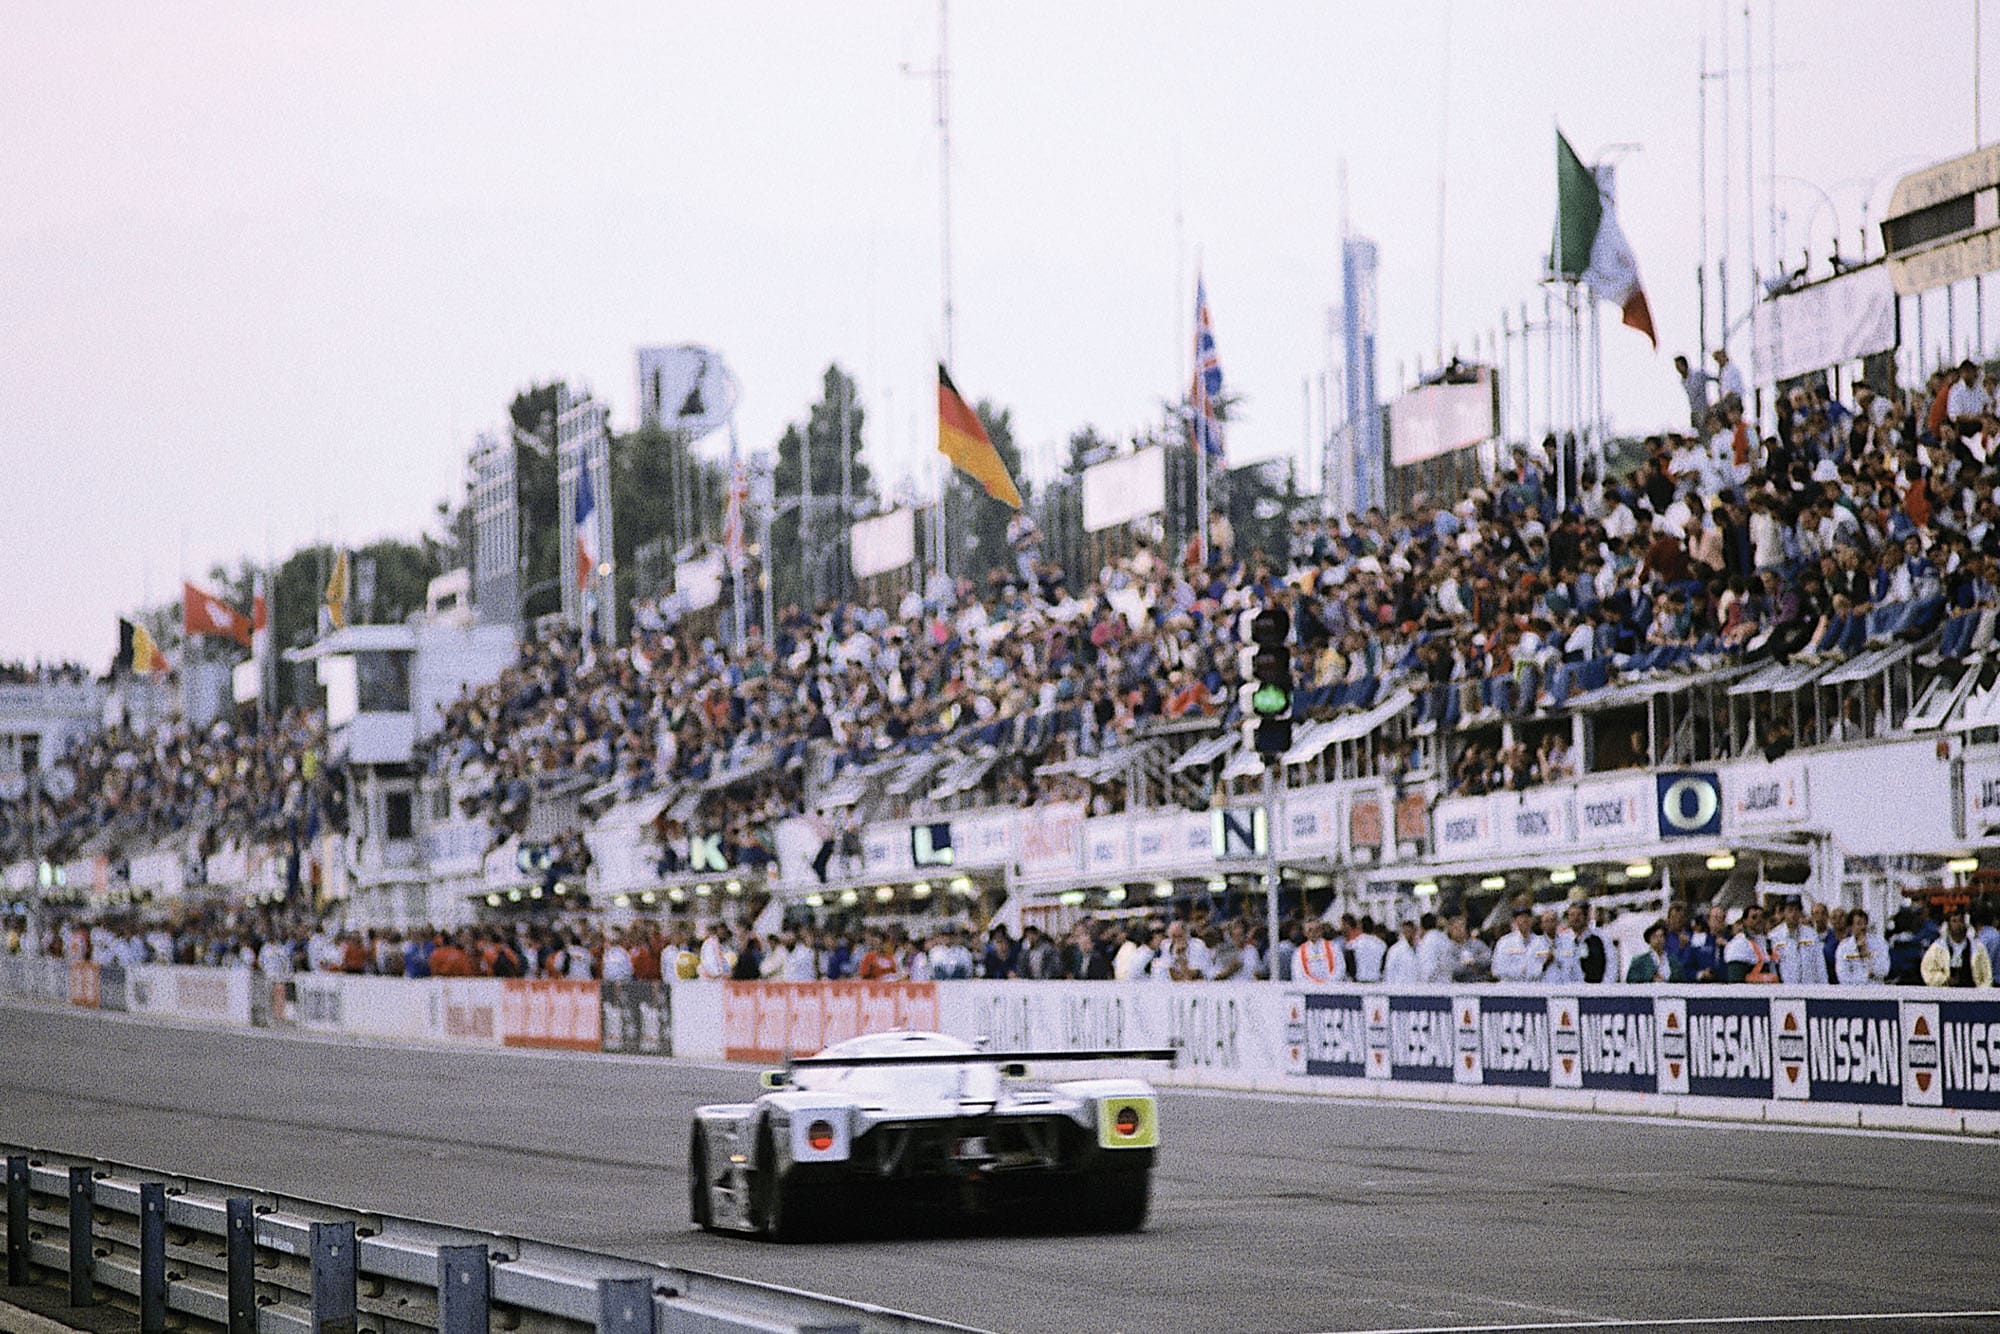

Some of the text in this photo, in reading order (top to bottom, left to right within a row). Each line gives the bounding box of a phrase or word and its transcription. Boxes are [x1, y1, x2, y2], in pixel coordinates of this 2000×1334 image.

[690, 834, 727, 871] K
[913, 826, 953, 866] L
[1211, 808, 1267, 856] N
[1482, 1012, 1549, 1072] NISSAN
[1580, 1014, 1655, 1076] NISSAN
[1689, 1015, 1771, 1079] NISSAN
[1809, 1017, 1899, 1087] NISSAN
